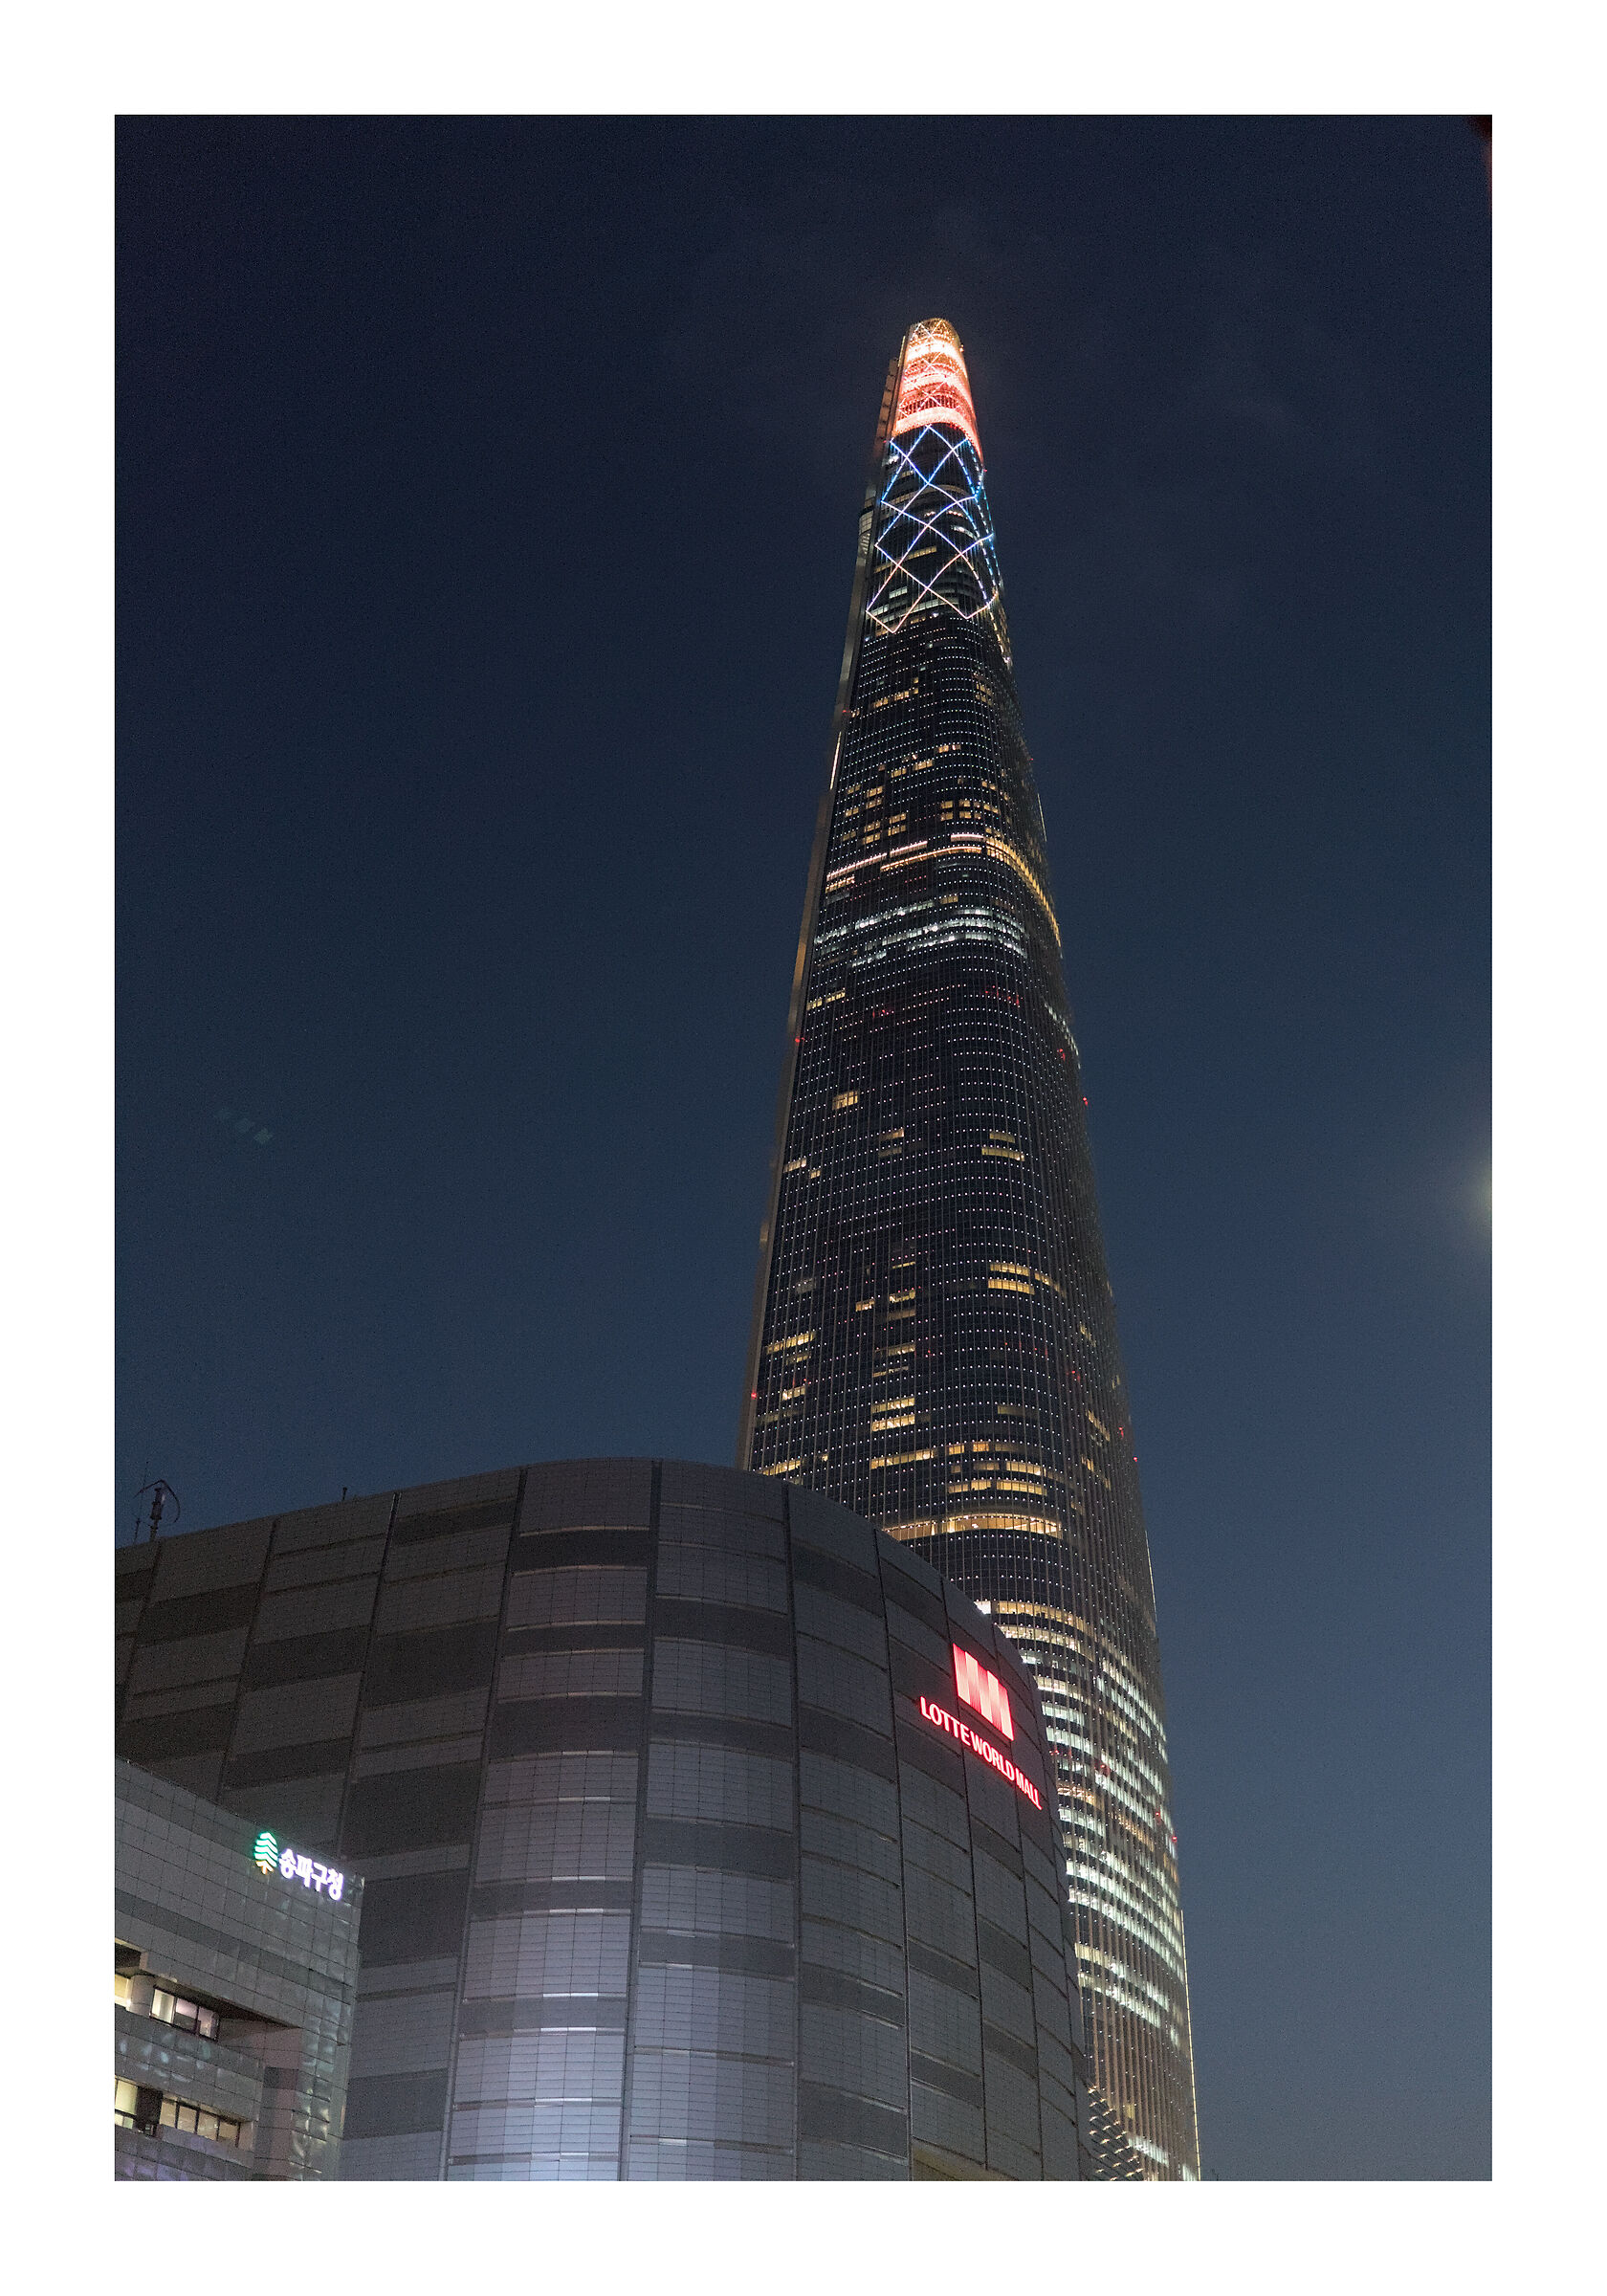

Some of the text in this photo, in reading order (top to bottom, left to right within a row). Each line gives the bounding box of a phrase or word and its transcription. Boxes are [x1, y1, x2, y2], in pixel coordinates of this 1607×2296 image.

[919, 1695, 1043, 1810] LOTTE WORLD MALL
[278, 1847, 344, 1901] 송파구청
